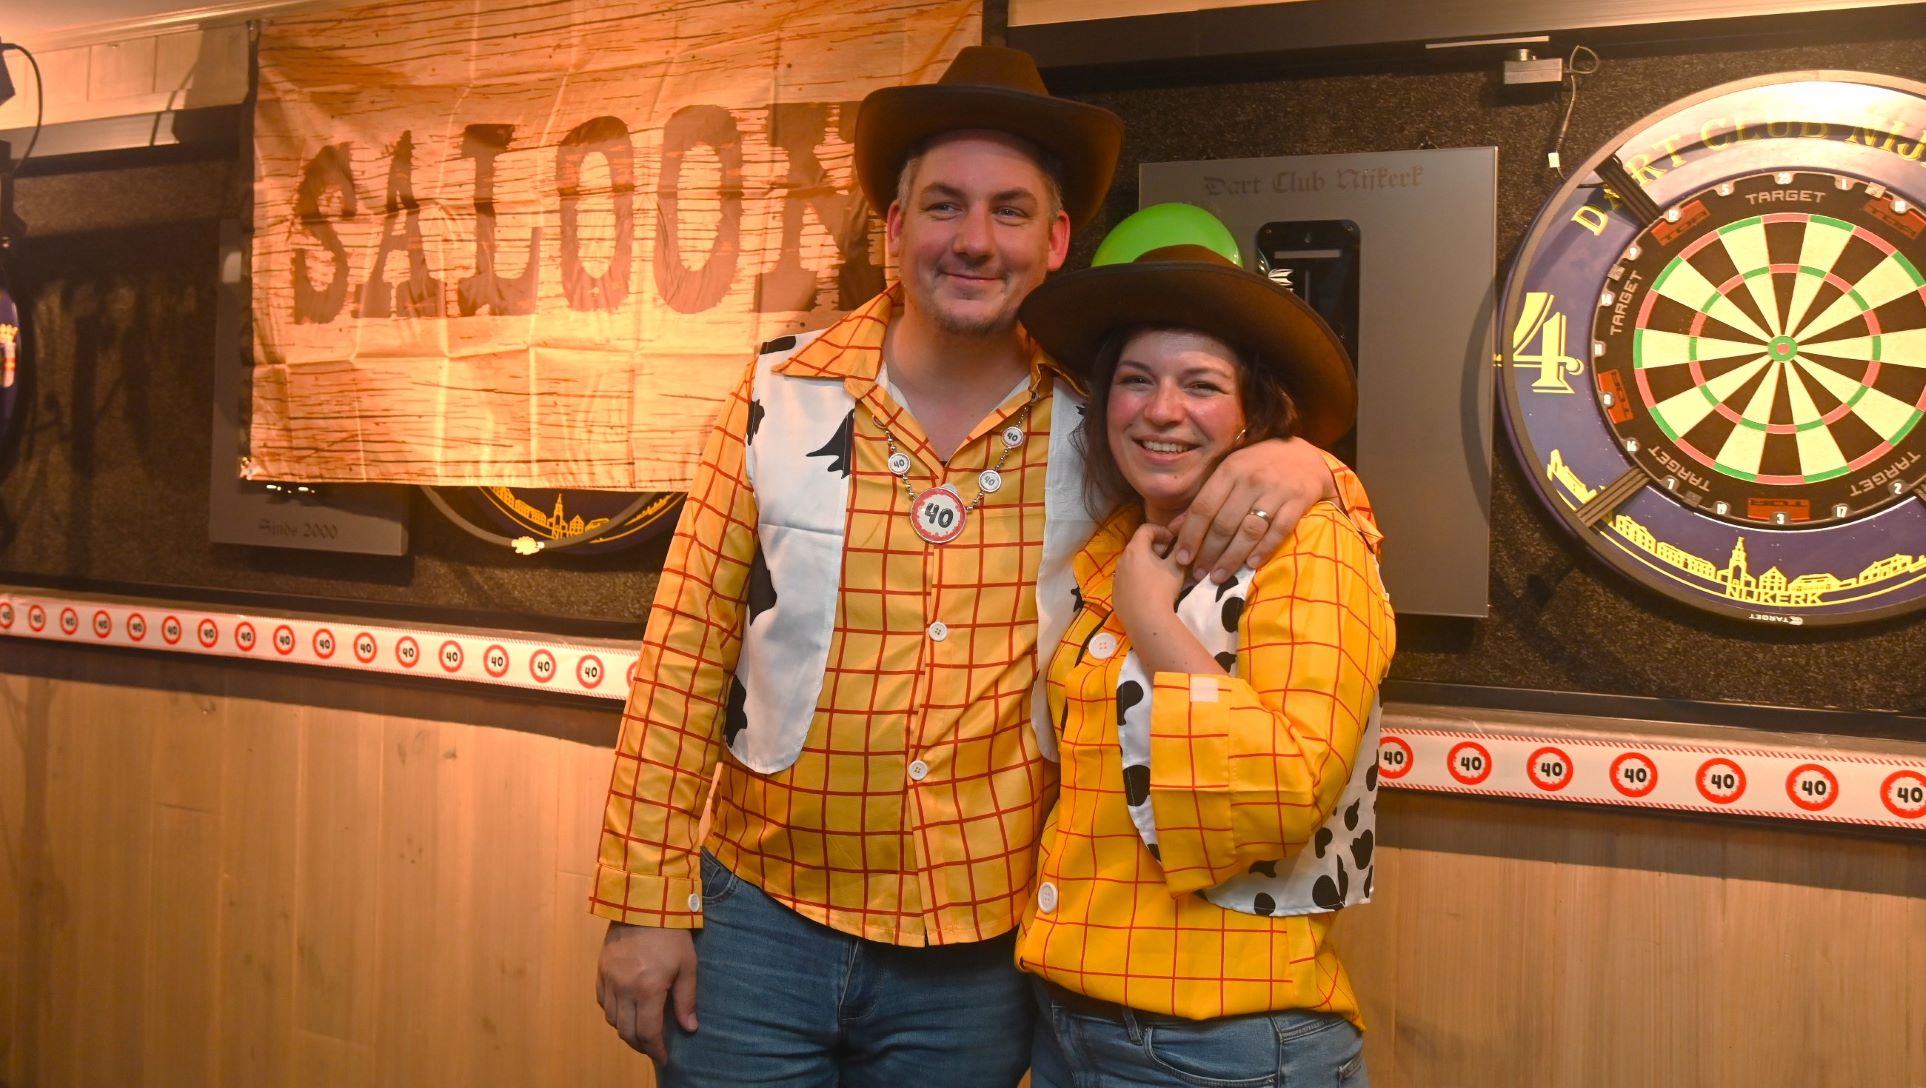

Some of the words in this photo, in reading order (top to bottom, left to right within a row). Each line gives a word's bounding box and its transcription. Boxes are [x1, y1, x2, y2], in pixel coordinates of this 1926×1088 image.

[1204, 176, 1262, 196] Dart
[1272, 171, 1326, 193] Club
[1336, 164, 1424, 192] Nijkerk
[1746, 190, 1826, 205] TARGET
[1610, 270, 1643, 336] TARGET
[1007, 432, 1019, 442] 40
[893, 459, 906, 469] 40
[1648, 445, 1710, 493] TARGET
[1850, 451, 1921, 497] TARGET
[984, 475, 996, 488] 40
[1667, 478, 1675, 491] 7
[1894, 482, 1902, 494] 2
[924, 502, 955, 530] 40
[1836, 506, 1848, 518] 17
[1776, 513, 1785, 525] 3
[303, 521, 338, 540] 2000
[1726, 583, 1825, 607] NIJKERK
[1748, 613, 1789, 623] TARGET
[167, 625, 178, 636] 40
[203, 628, 214, 639] 40
[240, 632, 252, 643] 40
[279, 635, 291, 646] 40
[319, 639, 331, 650] 40
[360, 642, 372, 654] 40
[403, 646, 415, 659] 40
[446, 651, 459, 663] 40
[492, 655, 504, 668] 40
[538, 660, 550, 673] 40
[584, 666, 599, 679] 40
[1383, 750, 1404, 765] 40
[1460, 755, 1482, 771] 40
[1541, 761, 1563, 777] 40
[1624, 766, 1647, 783] 40
[1711, 773, 1735, 790] 40
[1802, 779, 1827, 797] 40
[1897, 786, 1924, 804] 40
